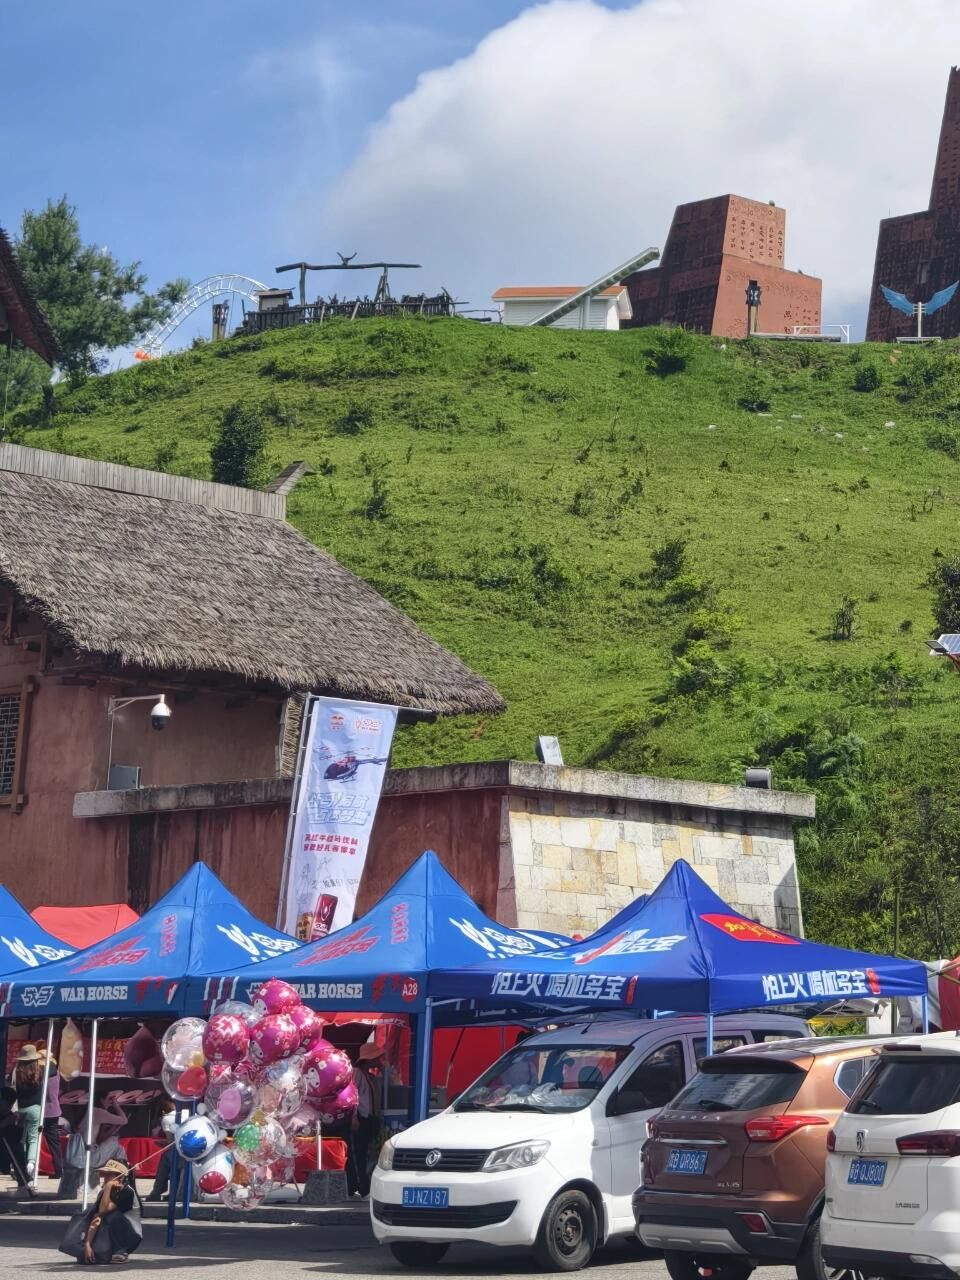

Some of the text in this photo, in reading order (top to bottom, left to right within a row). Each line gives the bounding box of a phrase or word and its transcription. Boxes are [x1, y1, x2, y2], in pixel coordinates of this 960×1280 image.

[60, 985, 128, 1002] WAR HORSE
[317, 983, 363, 999] HORSE
[402, 983, 418, 996] A28
[490, 972, 626, 1001] 怕上火 喝加多宝
[761, 969, 869, 1001] 怕上火 喝加多宝
